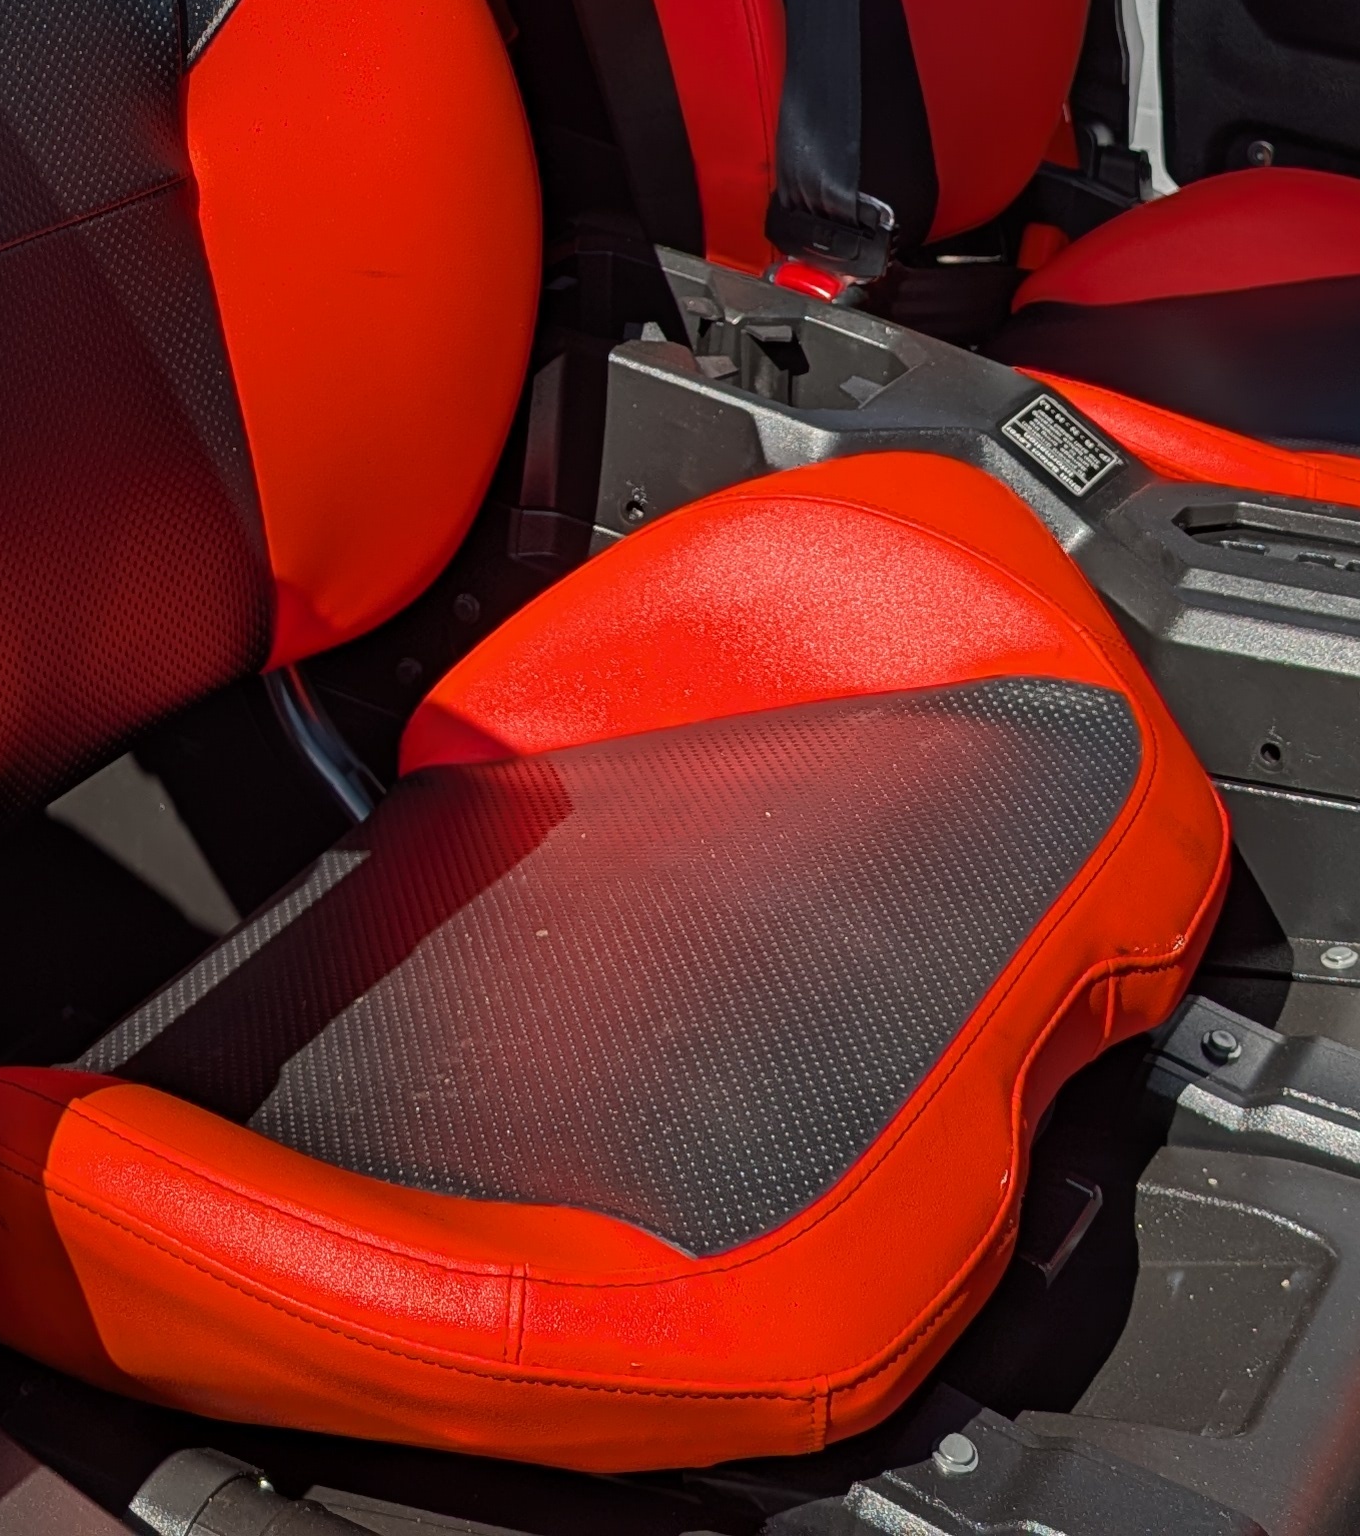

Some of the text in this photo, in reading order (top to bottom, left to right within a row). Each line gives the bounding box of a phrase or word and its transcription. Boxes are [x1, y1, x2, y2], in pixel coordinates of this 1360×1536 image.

[1006, 426, 1080, 491] Shift Select Lever
[1023, 432, 1074, 476] Information
